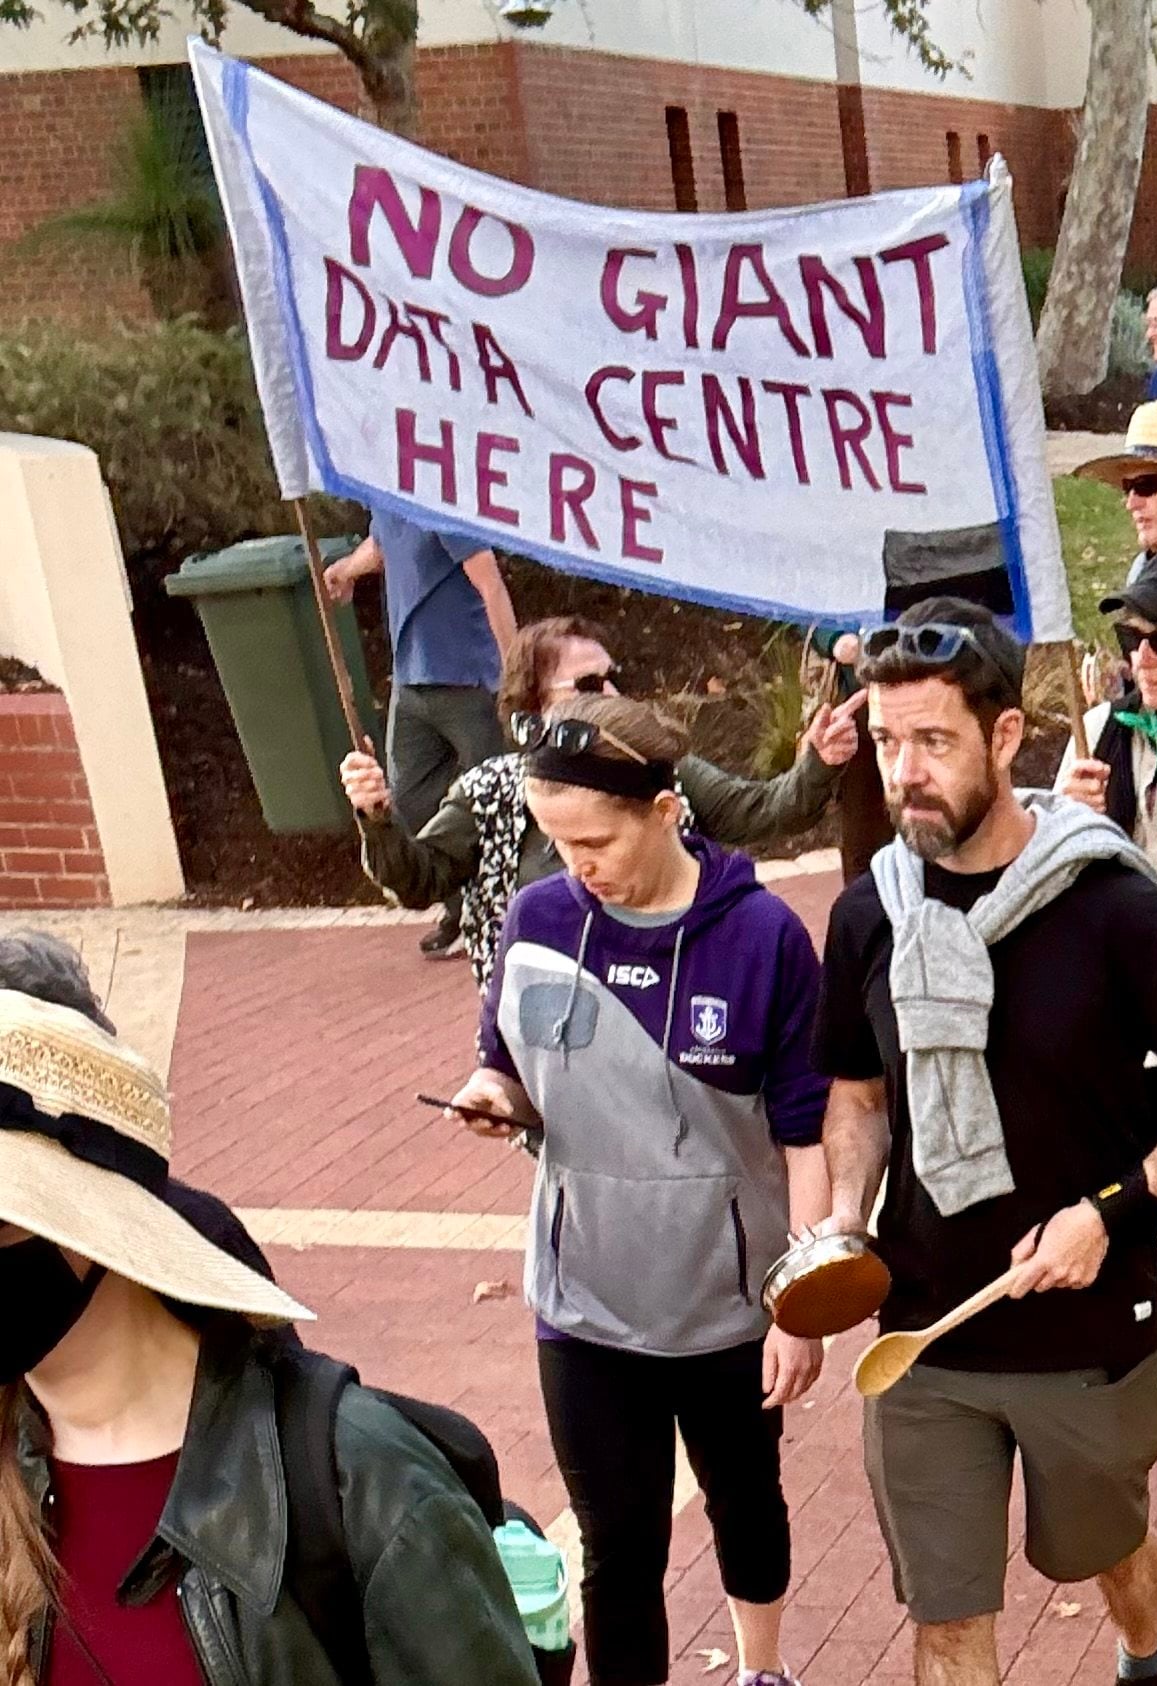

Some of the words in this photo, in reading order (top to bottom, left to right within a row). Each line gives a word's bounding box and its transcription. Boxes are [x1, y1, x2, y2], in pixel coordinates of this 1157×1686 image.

[348, 164, 536, 298] NO
[600, 232, 950, 359] GIANT
[323, 255, 536, 420] DATA
[585, 365, 927, 494] CENTRE
[395, 406, 665, 565] HERE
